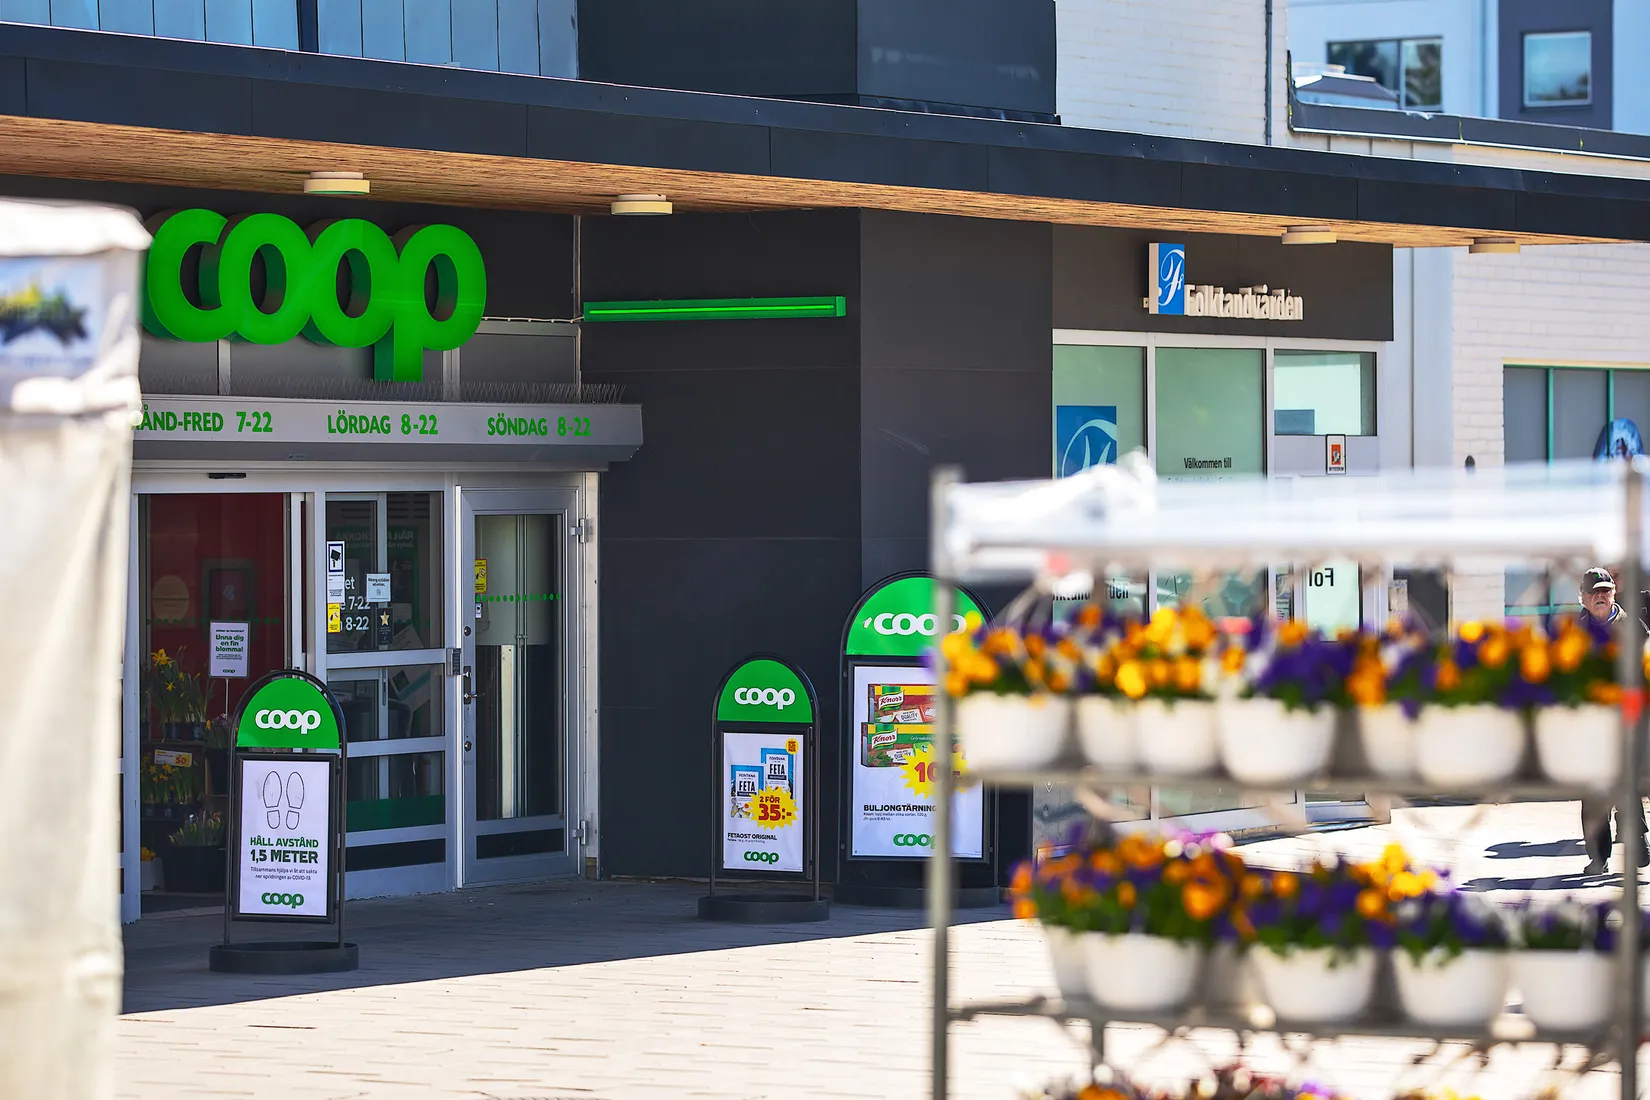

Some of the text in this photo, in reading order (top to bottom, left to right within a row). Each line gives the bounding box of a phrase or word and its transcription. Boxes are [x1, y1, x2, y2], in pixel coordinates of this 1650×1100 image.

[146, 208, 487, 382] coop
[1185, 284, 1303, 320] Folktandvården
[236, 411, 273, 432] 7-22
[327, 410, 438, 434] LÖRDAG 8-22
[487, 413, 591, 436] SÖNDAG 8-22
[1183, 457, 1232, 469] Välkommen till
[348, 596, 371, 610] 7-22
[345, 616, 369, 631] 8-22
[734, 687, 795, 710] coop
[879, 695, 903, 705] Knorr
[255, 709, 321, 734] coop
[873, 734, 896, 744] Knorr
[769, 764, 786, 775] FETA
[739, 781, 756, 791] FETA
[765, 794, 780, 803] FÖR
[758, 804, 792, 821] 35:-
[863, 803, 937, 812] BULJONGTÄRNING
[250, 835, 319, 848] HÅLL AVSTÅND
[727, 832, 751, 840] FETAOST
[250, 849, 318, 863] 1,5 METER
[743, 851, 779, 865] coop
[261, 892, 304, 909] coop
